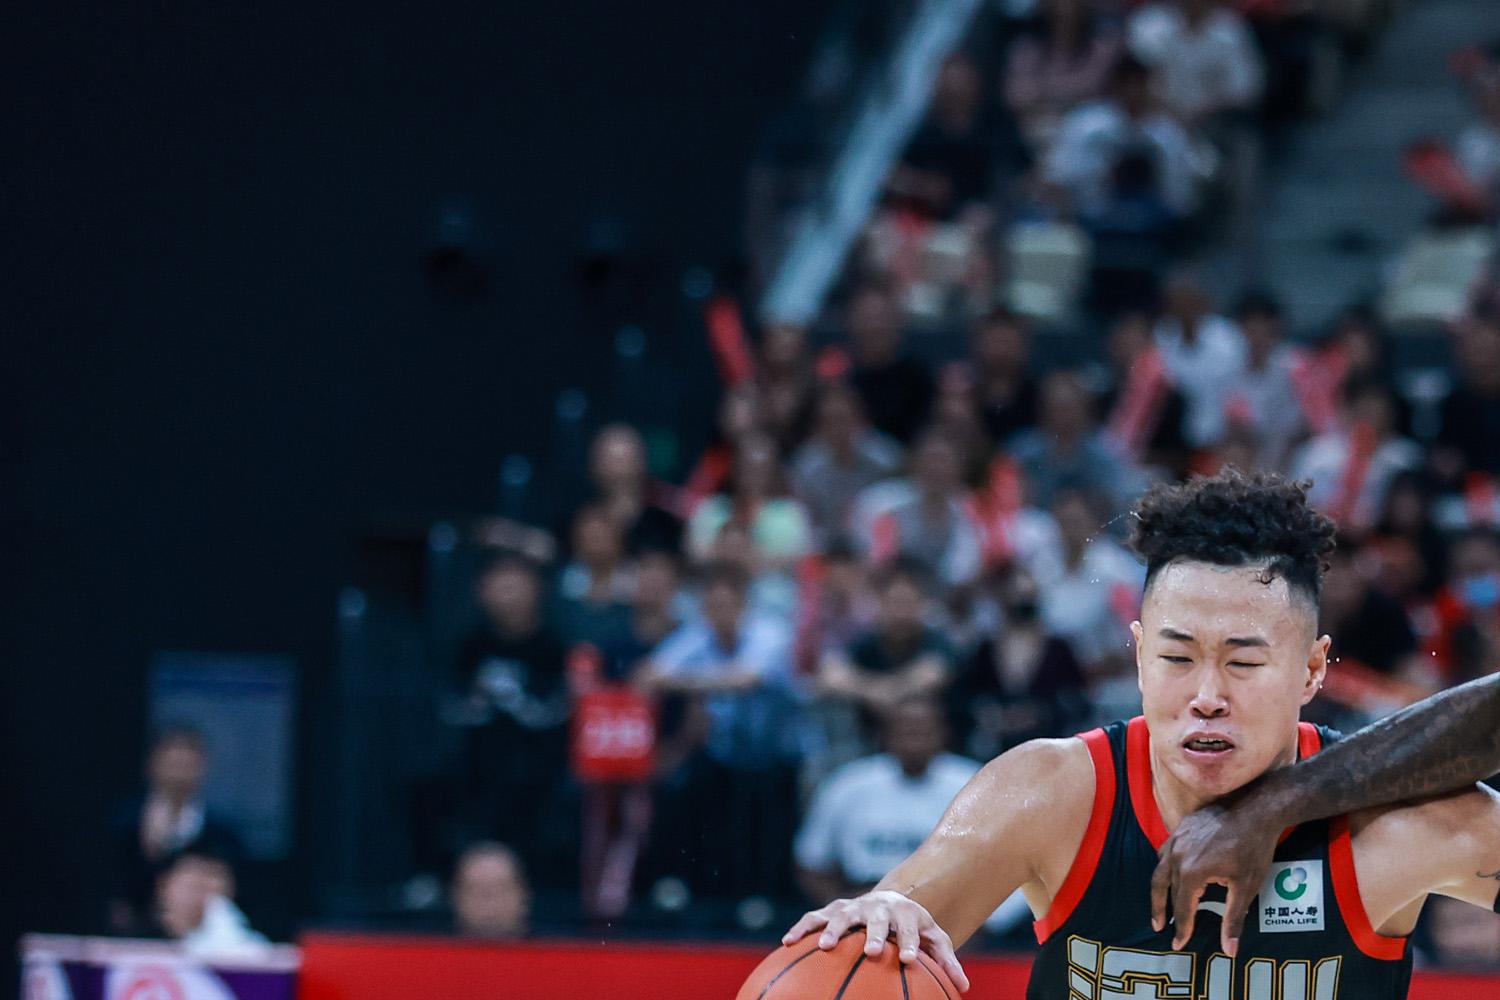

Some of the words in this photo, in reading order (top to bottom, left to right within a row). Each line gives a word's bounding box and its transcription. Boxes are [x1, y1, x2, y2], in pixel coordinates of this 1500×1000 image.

[1264, 905, 1319, 918] 中国人寿
[1264, 918, 1295, 926] CHINA
[1297, 917, 1318, 925] LIFE
